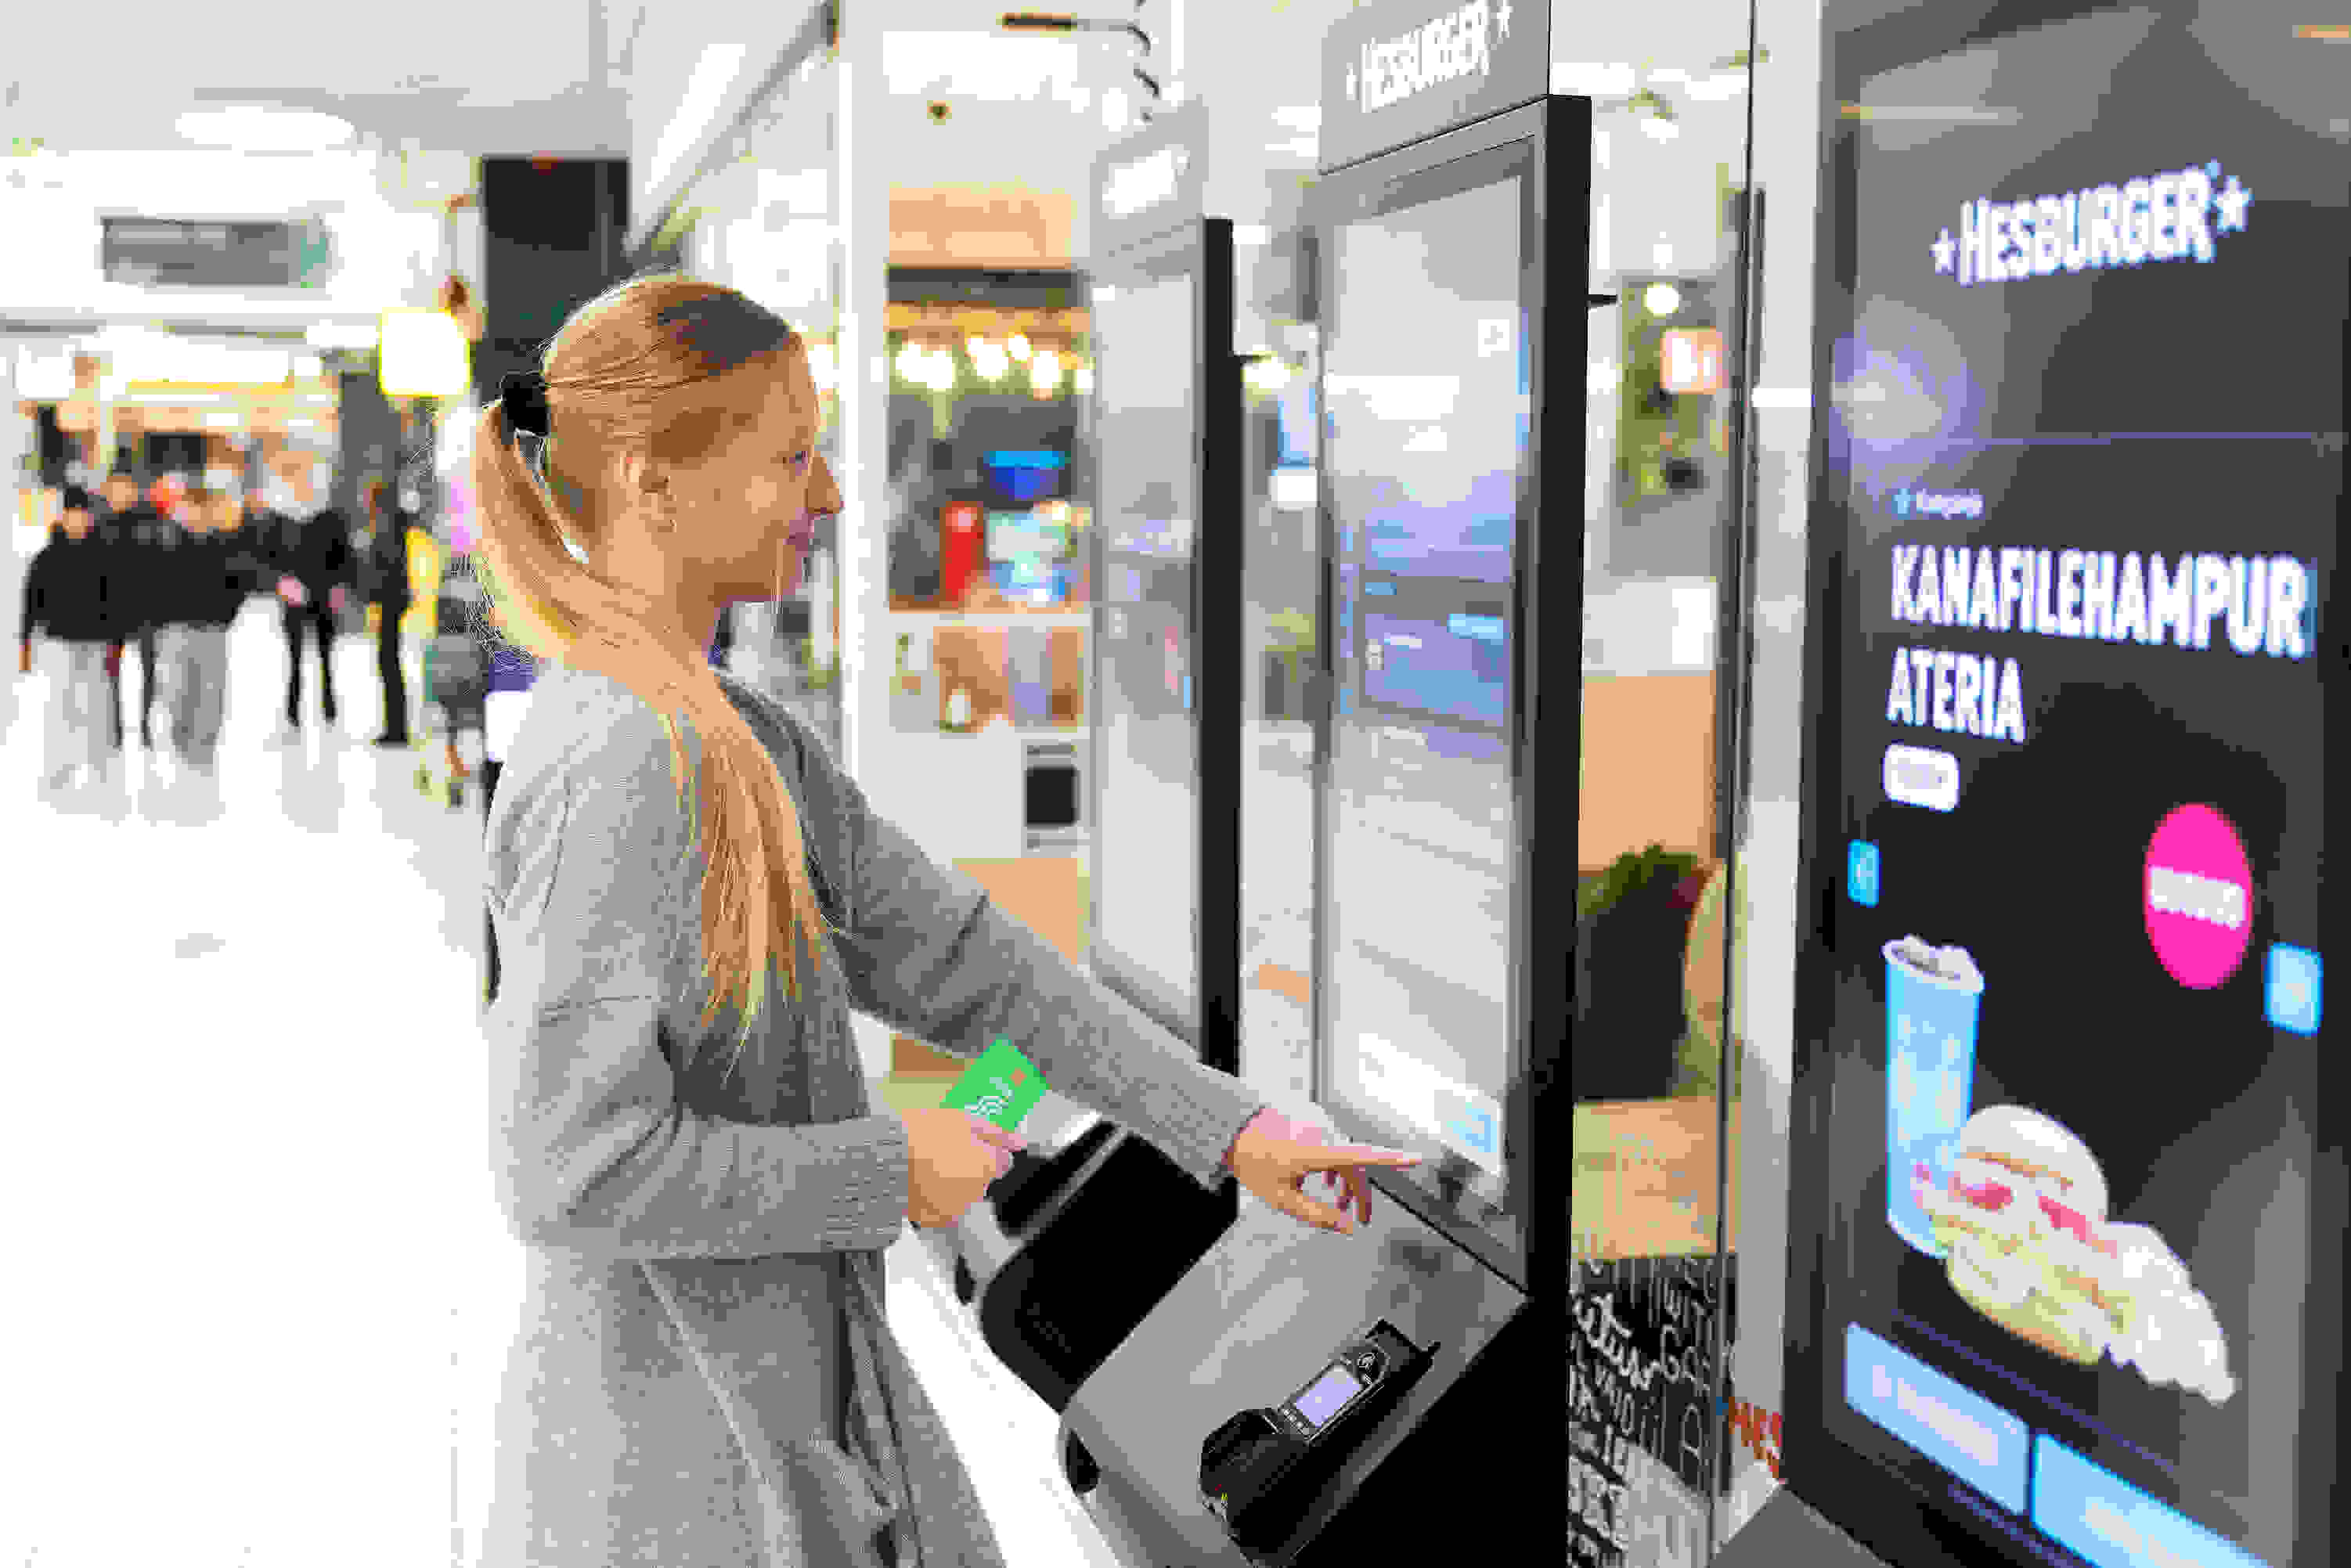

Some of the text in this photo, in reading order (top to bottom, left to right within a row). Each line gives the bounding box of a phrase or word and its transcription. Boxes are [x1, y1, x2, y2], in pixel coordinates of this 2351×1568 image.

[1360, 0, 1489, 113] HESBURGER
[1960, 168, 2215, 283] HESBURGER
[1891, 546, 2310, 659] KANAFILEHAMPUR
[1886, 648, 2026, 742] ATERIA
